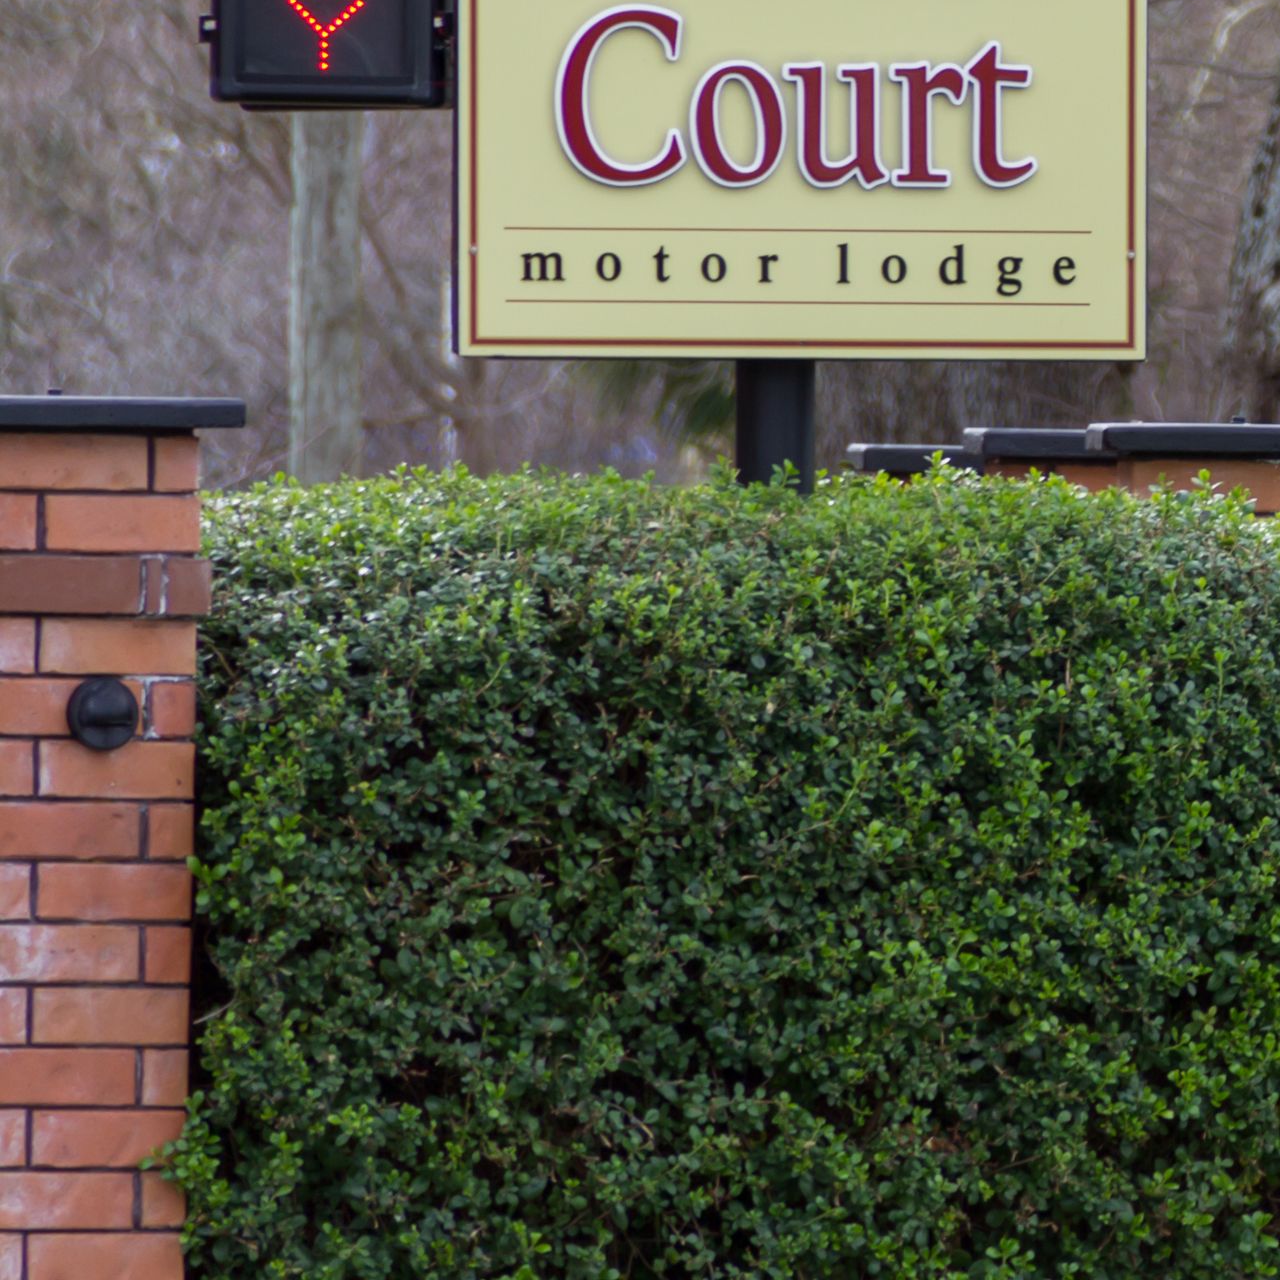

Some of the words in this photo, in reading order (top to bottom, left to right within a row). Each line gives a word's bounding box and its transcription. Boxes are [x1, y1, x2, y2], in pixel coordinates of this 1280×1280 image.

[555, 3, 1038, 188] Court
[522, 246, 778, 282] motor
[838, 244, 1077, 296] lodge
